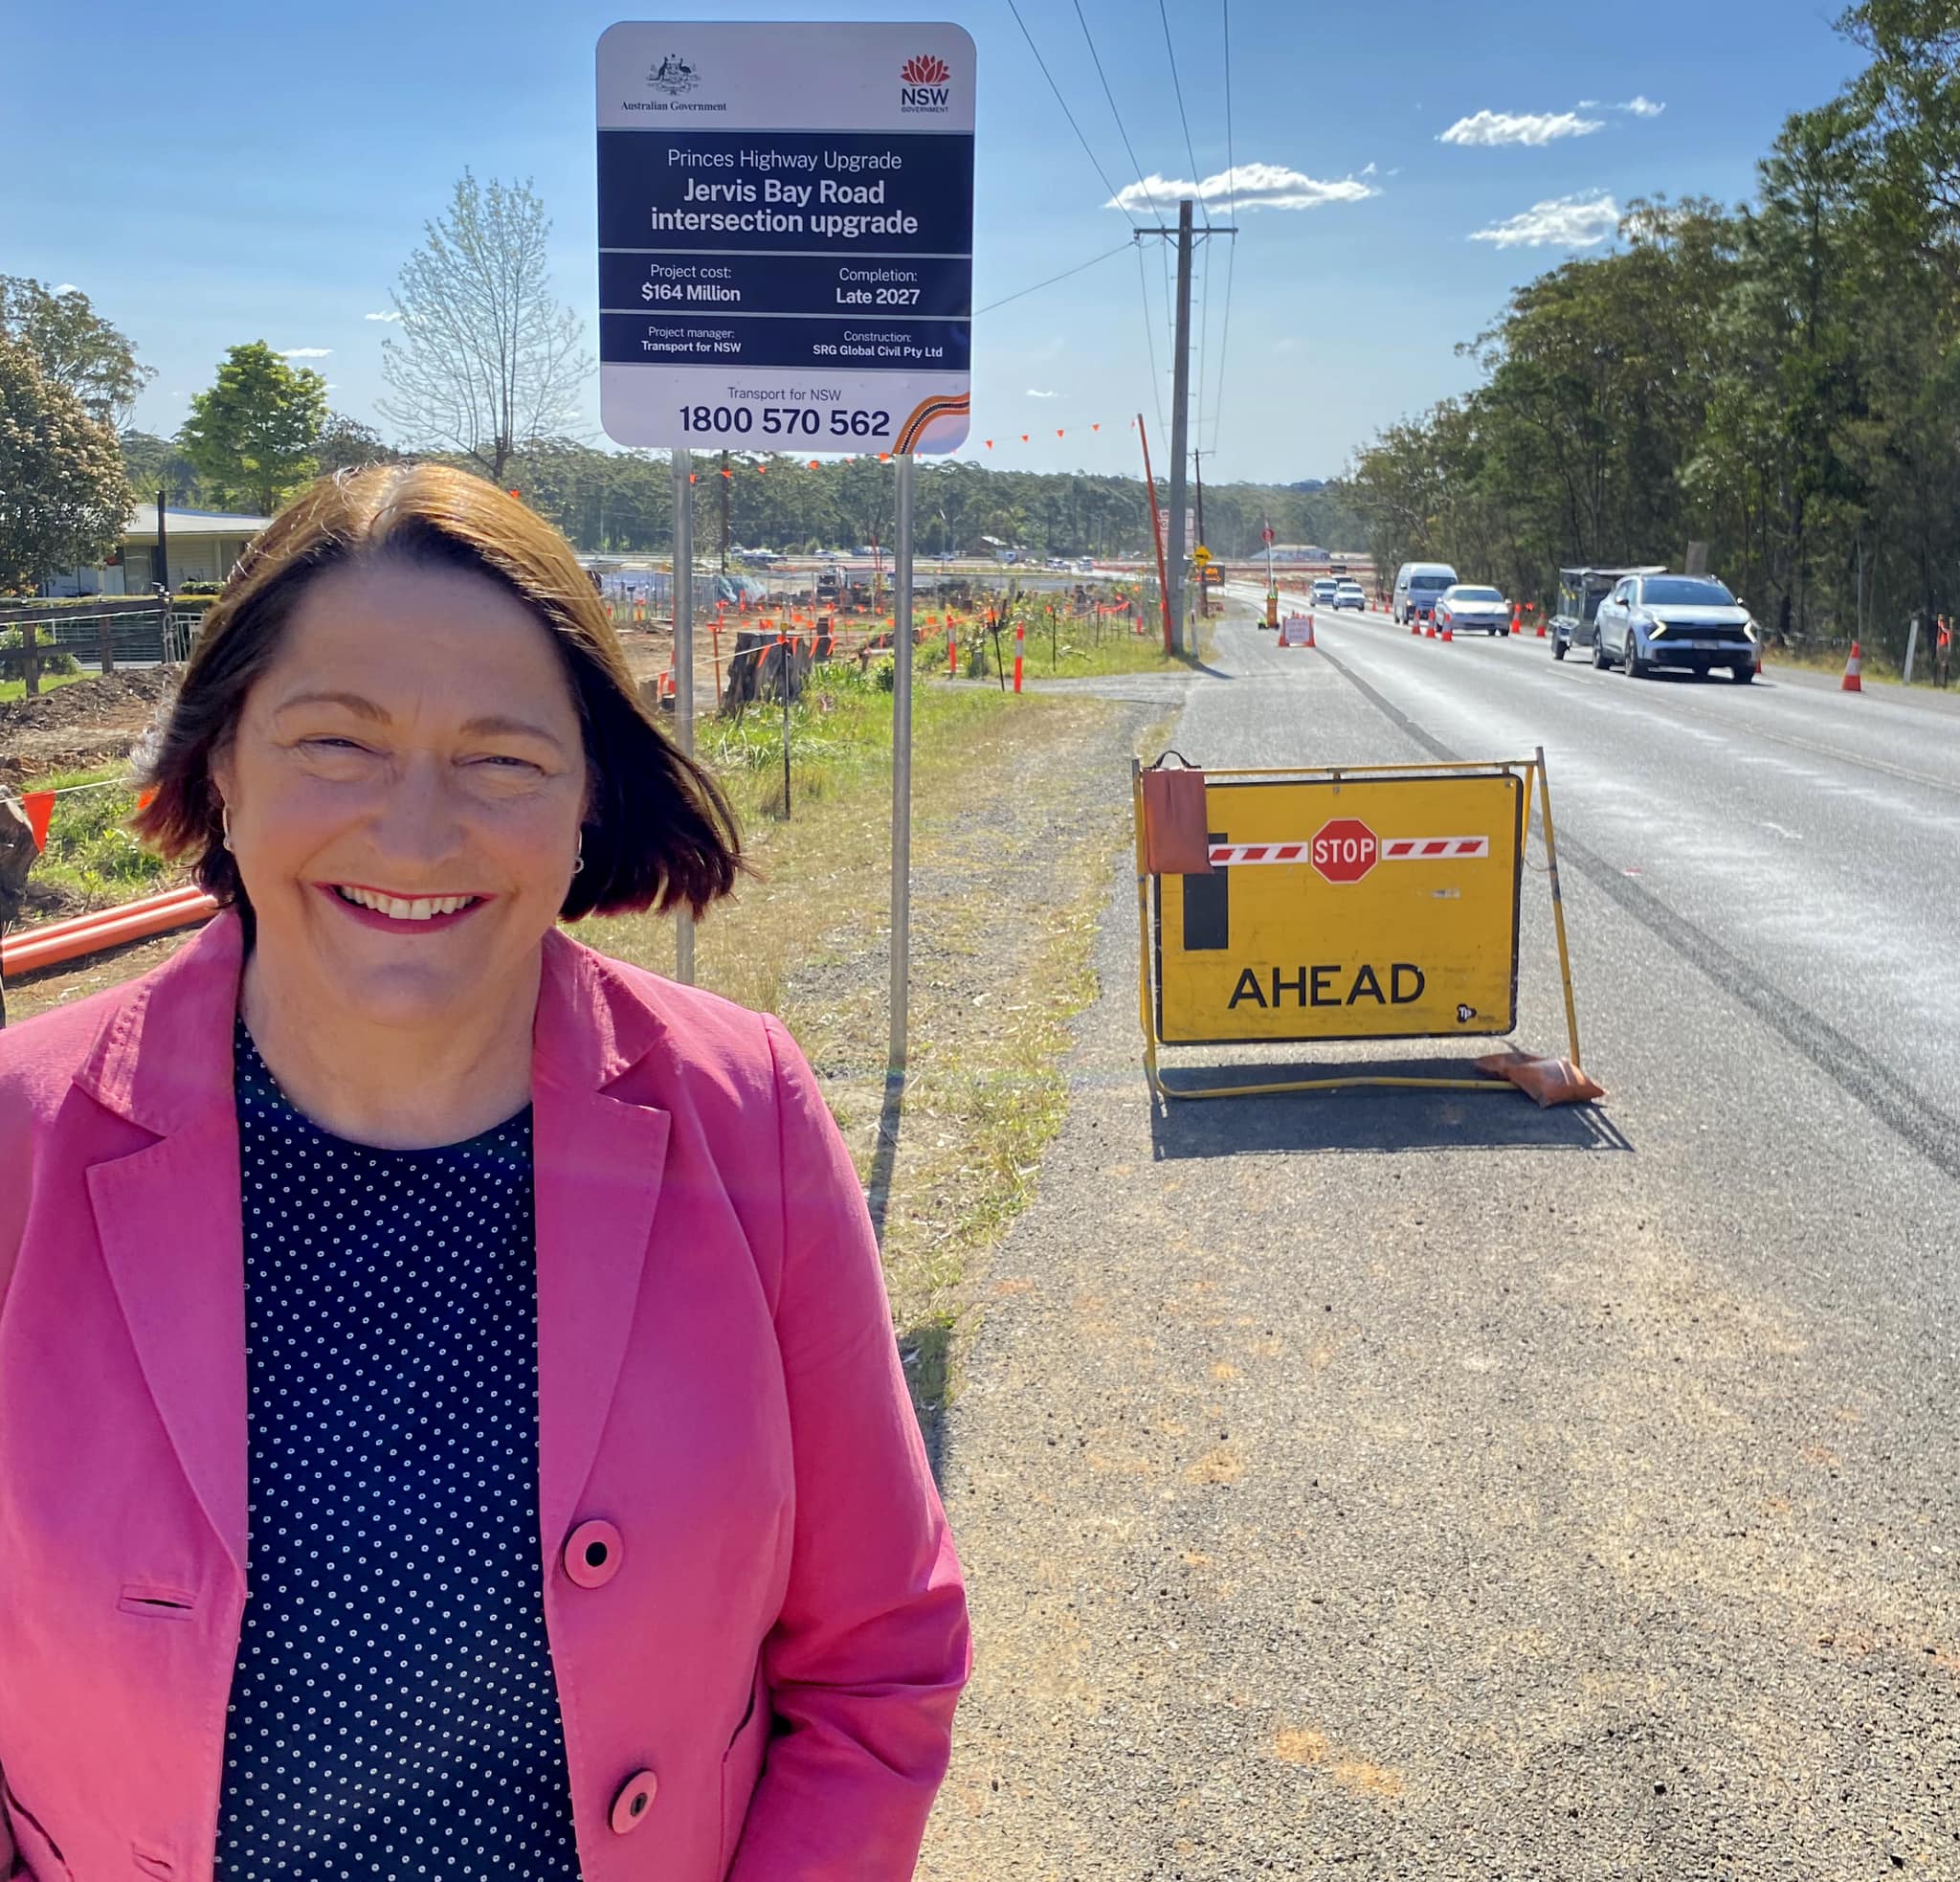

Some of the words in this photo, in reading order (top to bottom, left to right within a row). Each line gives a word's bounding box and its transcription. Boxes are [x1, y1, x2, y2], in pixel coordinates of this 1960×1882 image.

[902, 88, 948, 105] NSW
[622, 101, 668, 111] Australian
[670, 101, 726, 112] Government
[668, 149, 733, 168] Princes
[740, 150, 817, 170] Highway
[824, 151, 902, 171] Upgrade
[683, 179, 756, 202] Jervis
[765, 180, 812, 208] Bay
[819, 181, 884, 203] Road
[652, 207, 803, 232] intersection
[811, 211, 918, 237] upgrade
[651, 265, 697, 280] Project
[701, 266, 731, 279] cost:
[838, 268, 917, 283] Completion:
[641, 283, 682, 301] $164
[686, 285, 741, 301] Million
[836, 287, 872, 304] Late
[876, 289, 920, 305] 2027
[649, 326, 684, 340] Project
[687, 329, 734, 341] manager:
[844, 331, 911, 343] Construction:
[641, 341, 693, 353] Transport
[696, 342, 711, 352] for
[714, 343, 741, 353] NSW
[813, 345, 836, 355] SRG
[839, 346, 875, 356] Global
[878, 346, 901, 357] Civil
[903, 347, 922, 359] Pty
[924, 347, 943, 357] Ltd
[727, 387, 785, 401] Transport
[791, 388, 807, 400] for
[811, 390, 841, 400] NSW
[679, 406, 752, 432] 1800
[762, 409, 819, 435] 570
[830, 411, 890, 436] 562
[1314, 838, 1374, 863] STOP
[1227, 963, 1426, 1010] AHEAD
